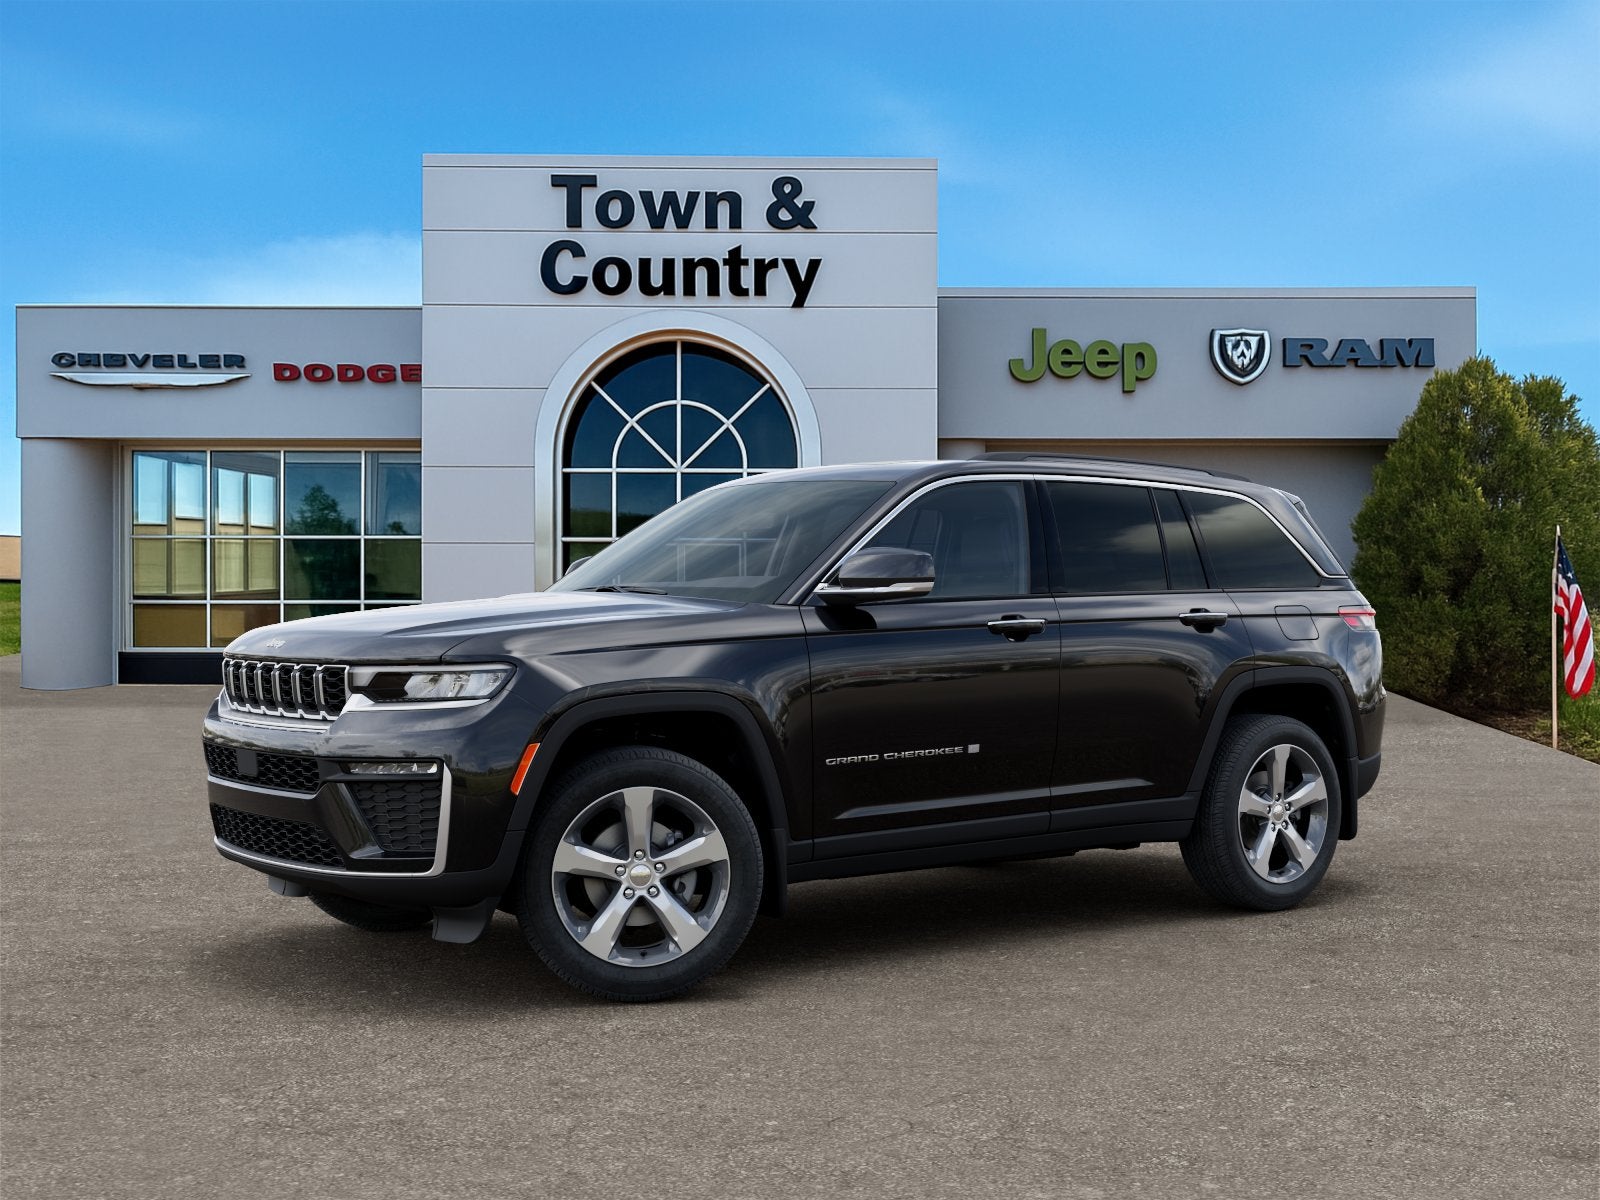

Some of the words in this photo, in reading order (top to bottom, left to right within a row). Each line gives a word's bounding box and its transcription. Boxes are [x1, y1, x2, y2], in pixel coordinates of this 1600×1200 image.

[550, 174, 742, 230] Town
[765, 175, 818, 230] &
[540, 239, 822, 308] Country
[272, 362, 422, 383] DODGE
[1009, 328, 1158, 393] Jeep
[1282, 337, 1436, 368] RAM
[825, 754, 879, 766] GRAND
[883, 746, 964, 760] CHEROKEE
